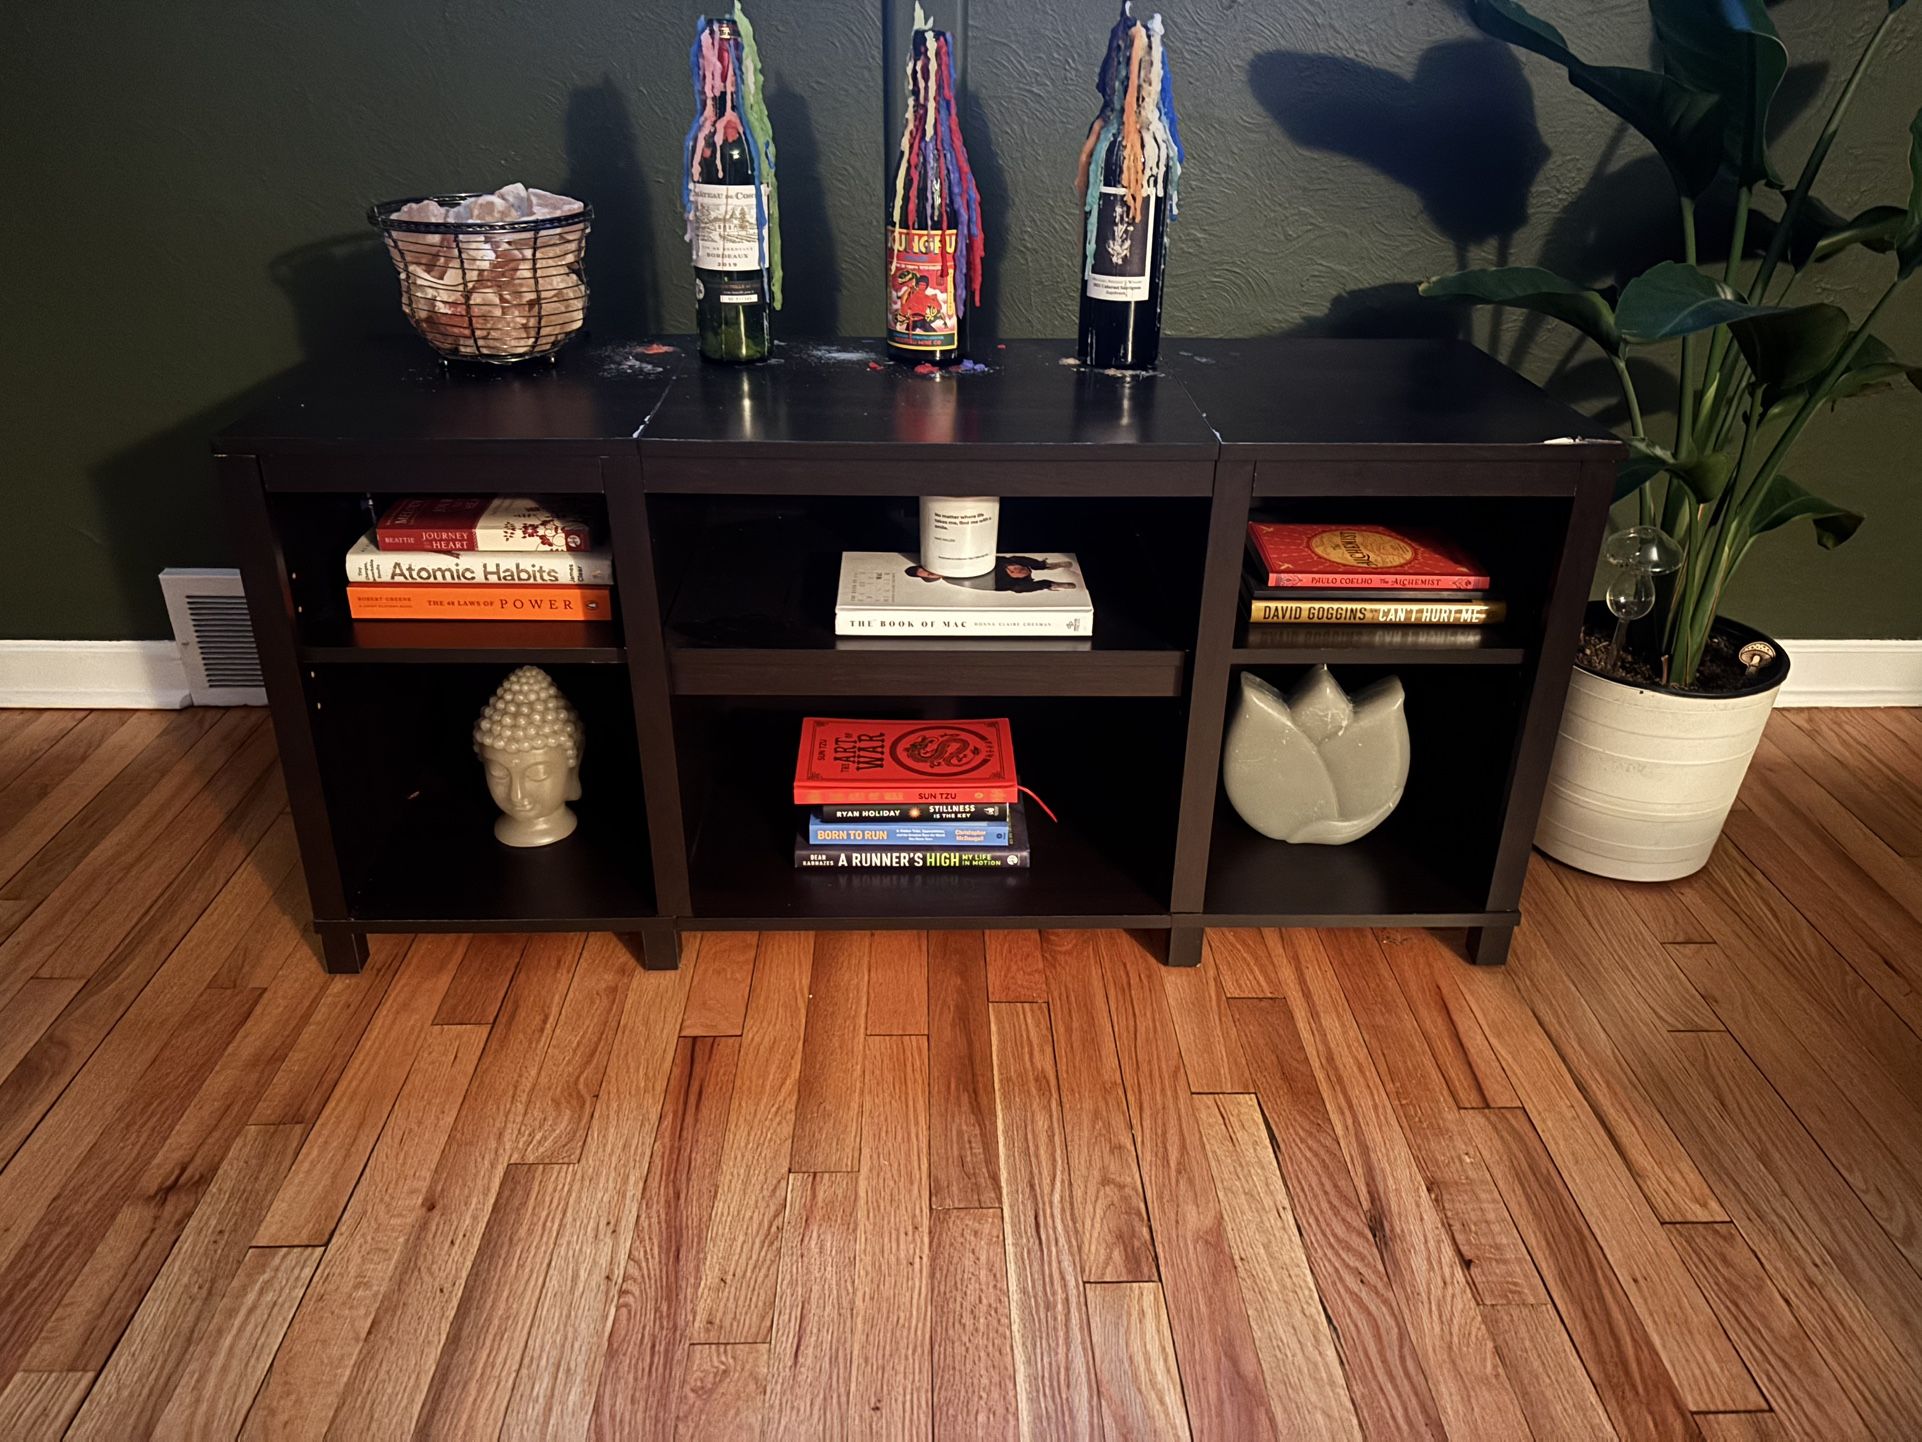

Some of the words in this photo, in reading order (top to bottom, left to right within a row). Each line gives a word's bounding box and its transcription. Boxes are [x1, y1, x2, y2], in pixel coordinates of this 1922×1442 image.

[421, 532, 468, 540] JOURNEY
[432, 541, 468, 549] HEART
[390, 561, 476, 582] Atomic
[482, 562, 559, 582] Habits
[1311, 577, 1338, 585] PAULO
[1340, 577, 1373, 585] COELHO
[1391, 577, 1441, 587] ALCHEMIST
[500, 598, 574, 610] POWER
[1263, 605, 1302, 620] DAVID
[1307, 606, 1368, 621] GOGGINS
[1378, 607, 1417, 622] CAN'T
[1421, 607, 1457, 622] HURT
[1460, 608, 1481, 622] ME
[849, 620, 873, 628] THE
[880, 620, 914, 628] BOOK
[921, 620, 935, 628] OF
[943, 620, 967, 628] MAC
[818, 739, 827, 749] TZU
[817, 750, 827, 761] SUN
[833, 737, 857, 764] ART
[856, 732, 886, 771] WAR
[918, 792, 937, 800] SUN
[939, 792, 957, 800] TZU
[862, 809, 901, 817] HOLIDAY
[928, 804, 976, 813] STILLNESS
[817, 830, 847, 840] BORN
[848, 830, 863, 840] TO
[864, 830, 888, 840] RUN
[838, 852, 848, 867] A
[852, 852, 924, 867] RUNNER'S
[926, 852, 960, 867] HIGH
[962, 853, 973, 861] MY
[974, 853, 991, 861] LIFE
